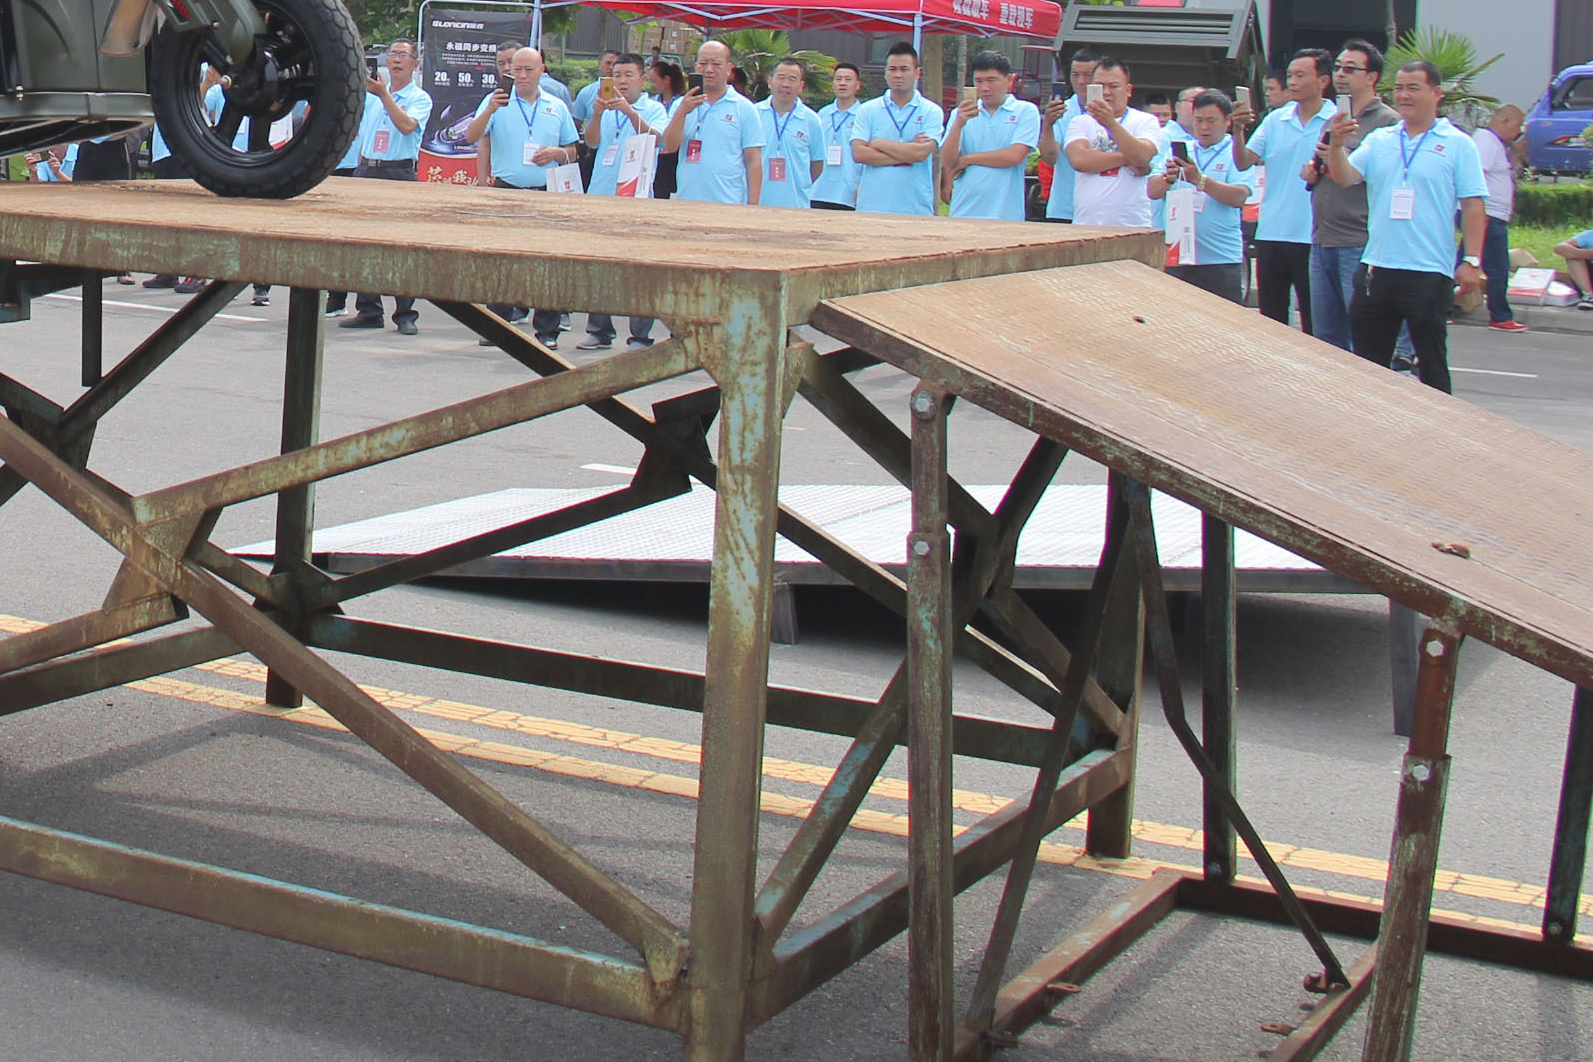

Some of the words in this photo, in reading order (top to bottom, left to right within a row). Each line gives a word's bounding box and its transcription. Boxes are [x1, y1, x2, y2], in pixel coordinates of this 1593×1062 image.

[446, 41, 500, 53] 永磁同步变频
